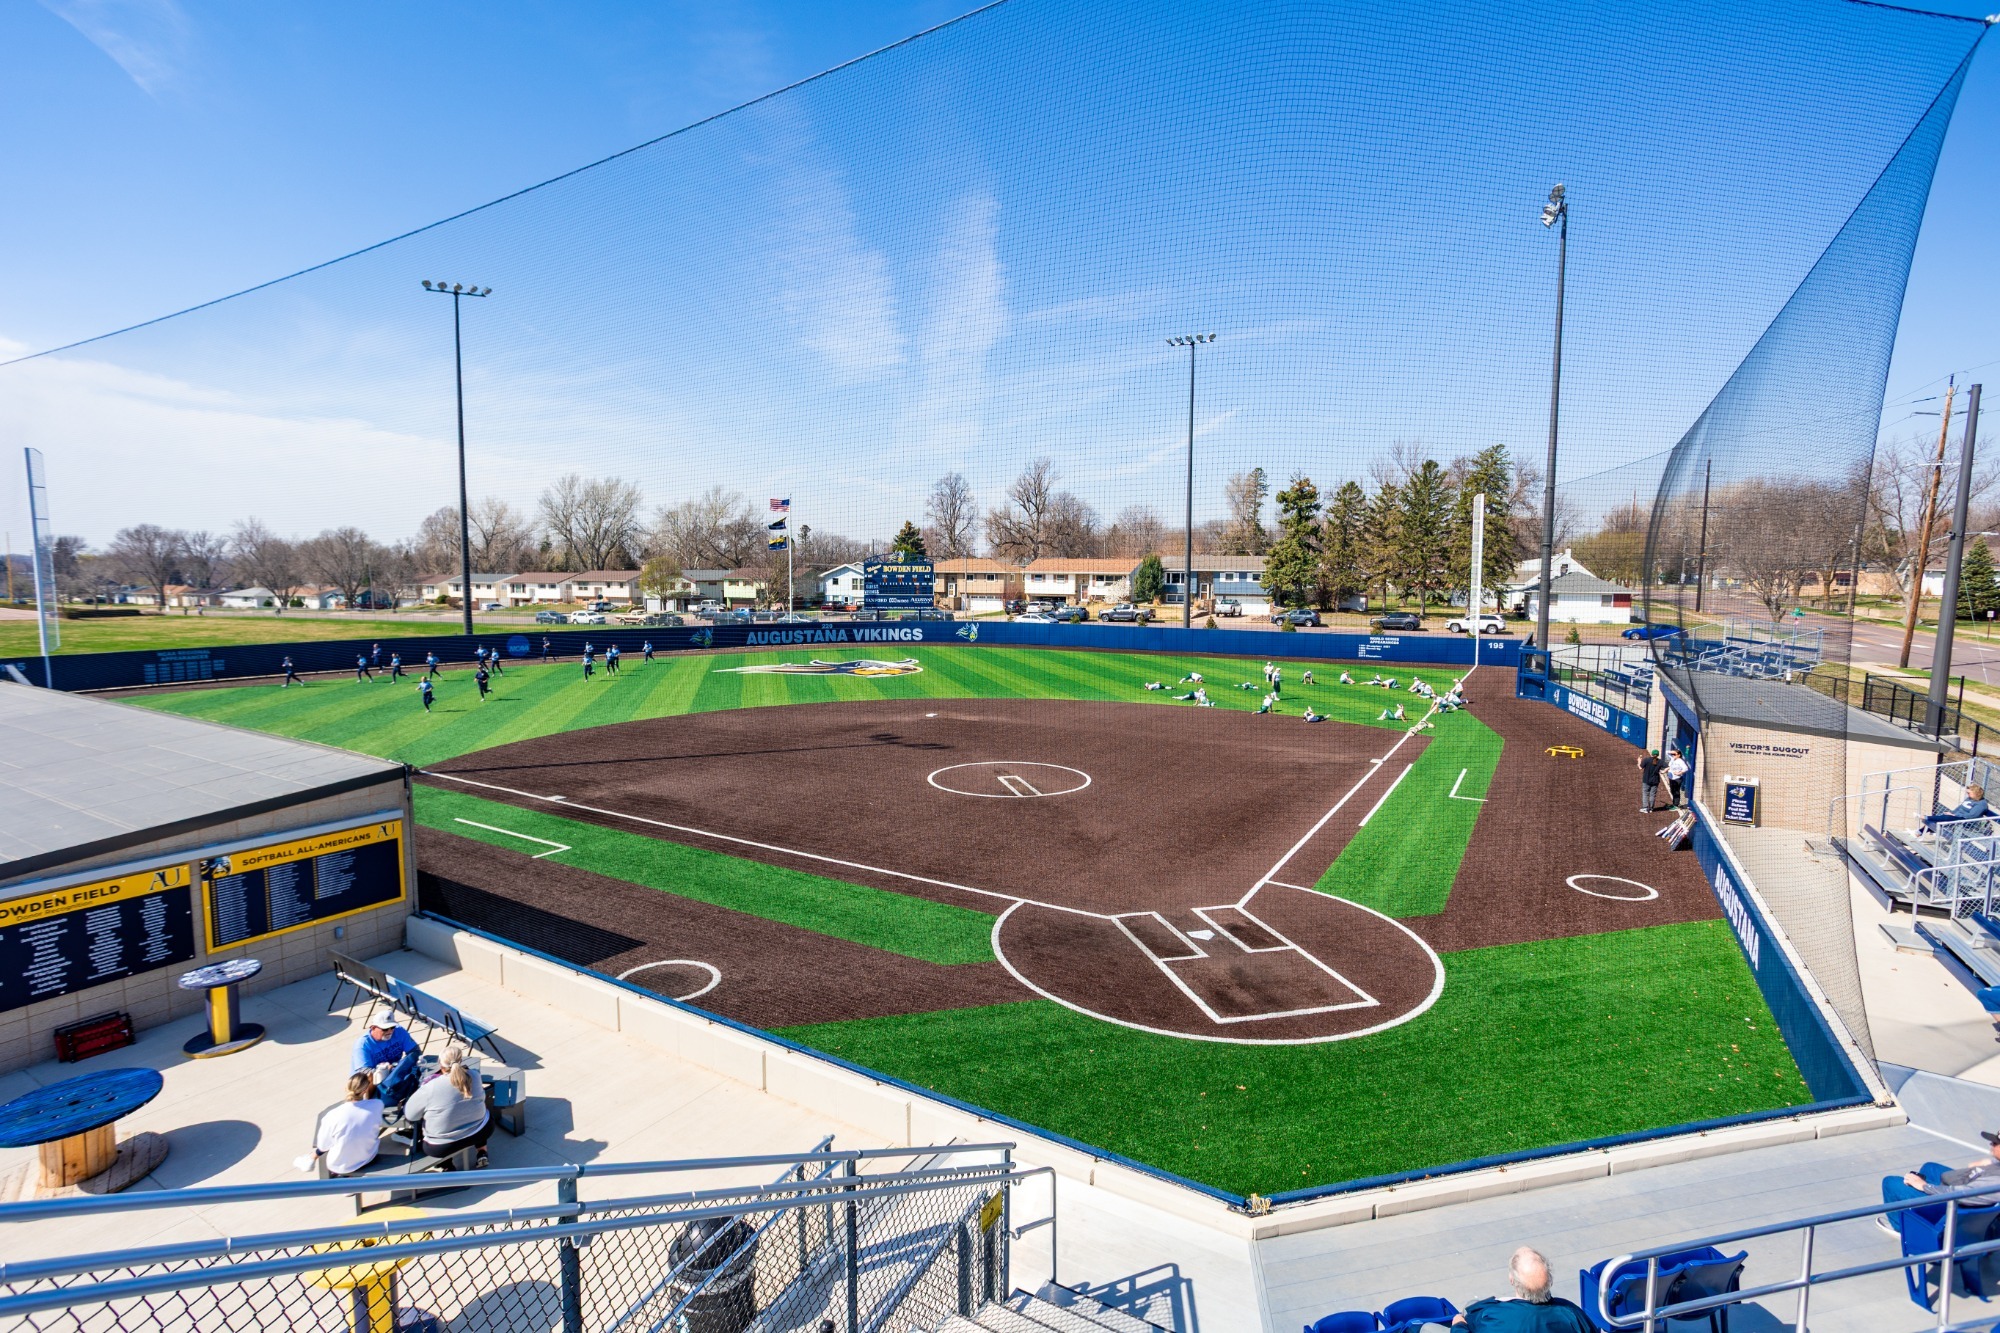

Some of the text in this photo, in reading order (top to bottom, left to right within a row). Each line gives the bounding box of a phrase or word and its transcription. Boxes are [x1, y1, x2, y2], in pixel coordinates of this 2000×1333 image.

[883, 565, 911, 573] BOWDEN
[912, 565, 931, 573] FIELD
[746, 627, 923, 645] AUGUSTANA VIKINGS
[1568, 692, 1610, 722] BOWDEN FIELD
[1729, 742, 1810, 754] VISITOR'S DUGOUT
[242, 833, 371, 867] SOFTBALL ALL-AMERICANS
[73, 885, 121, 902] FIELD
[1714, 862, 1759, 972] AUGUSTANA
